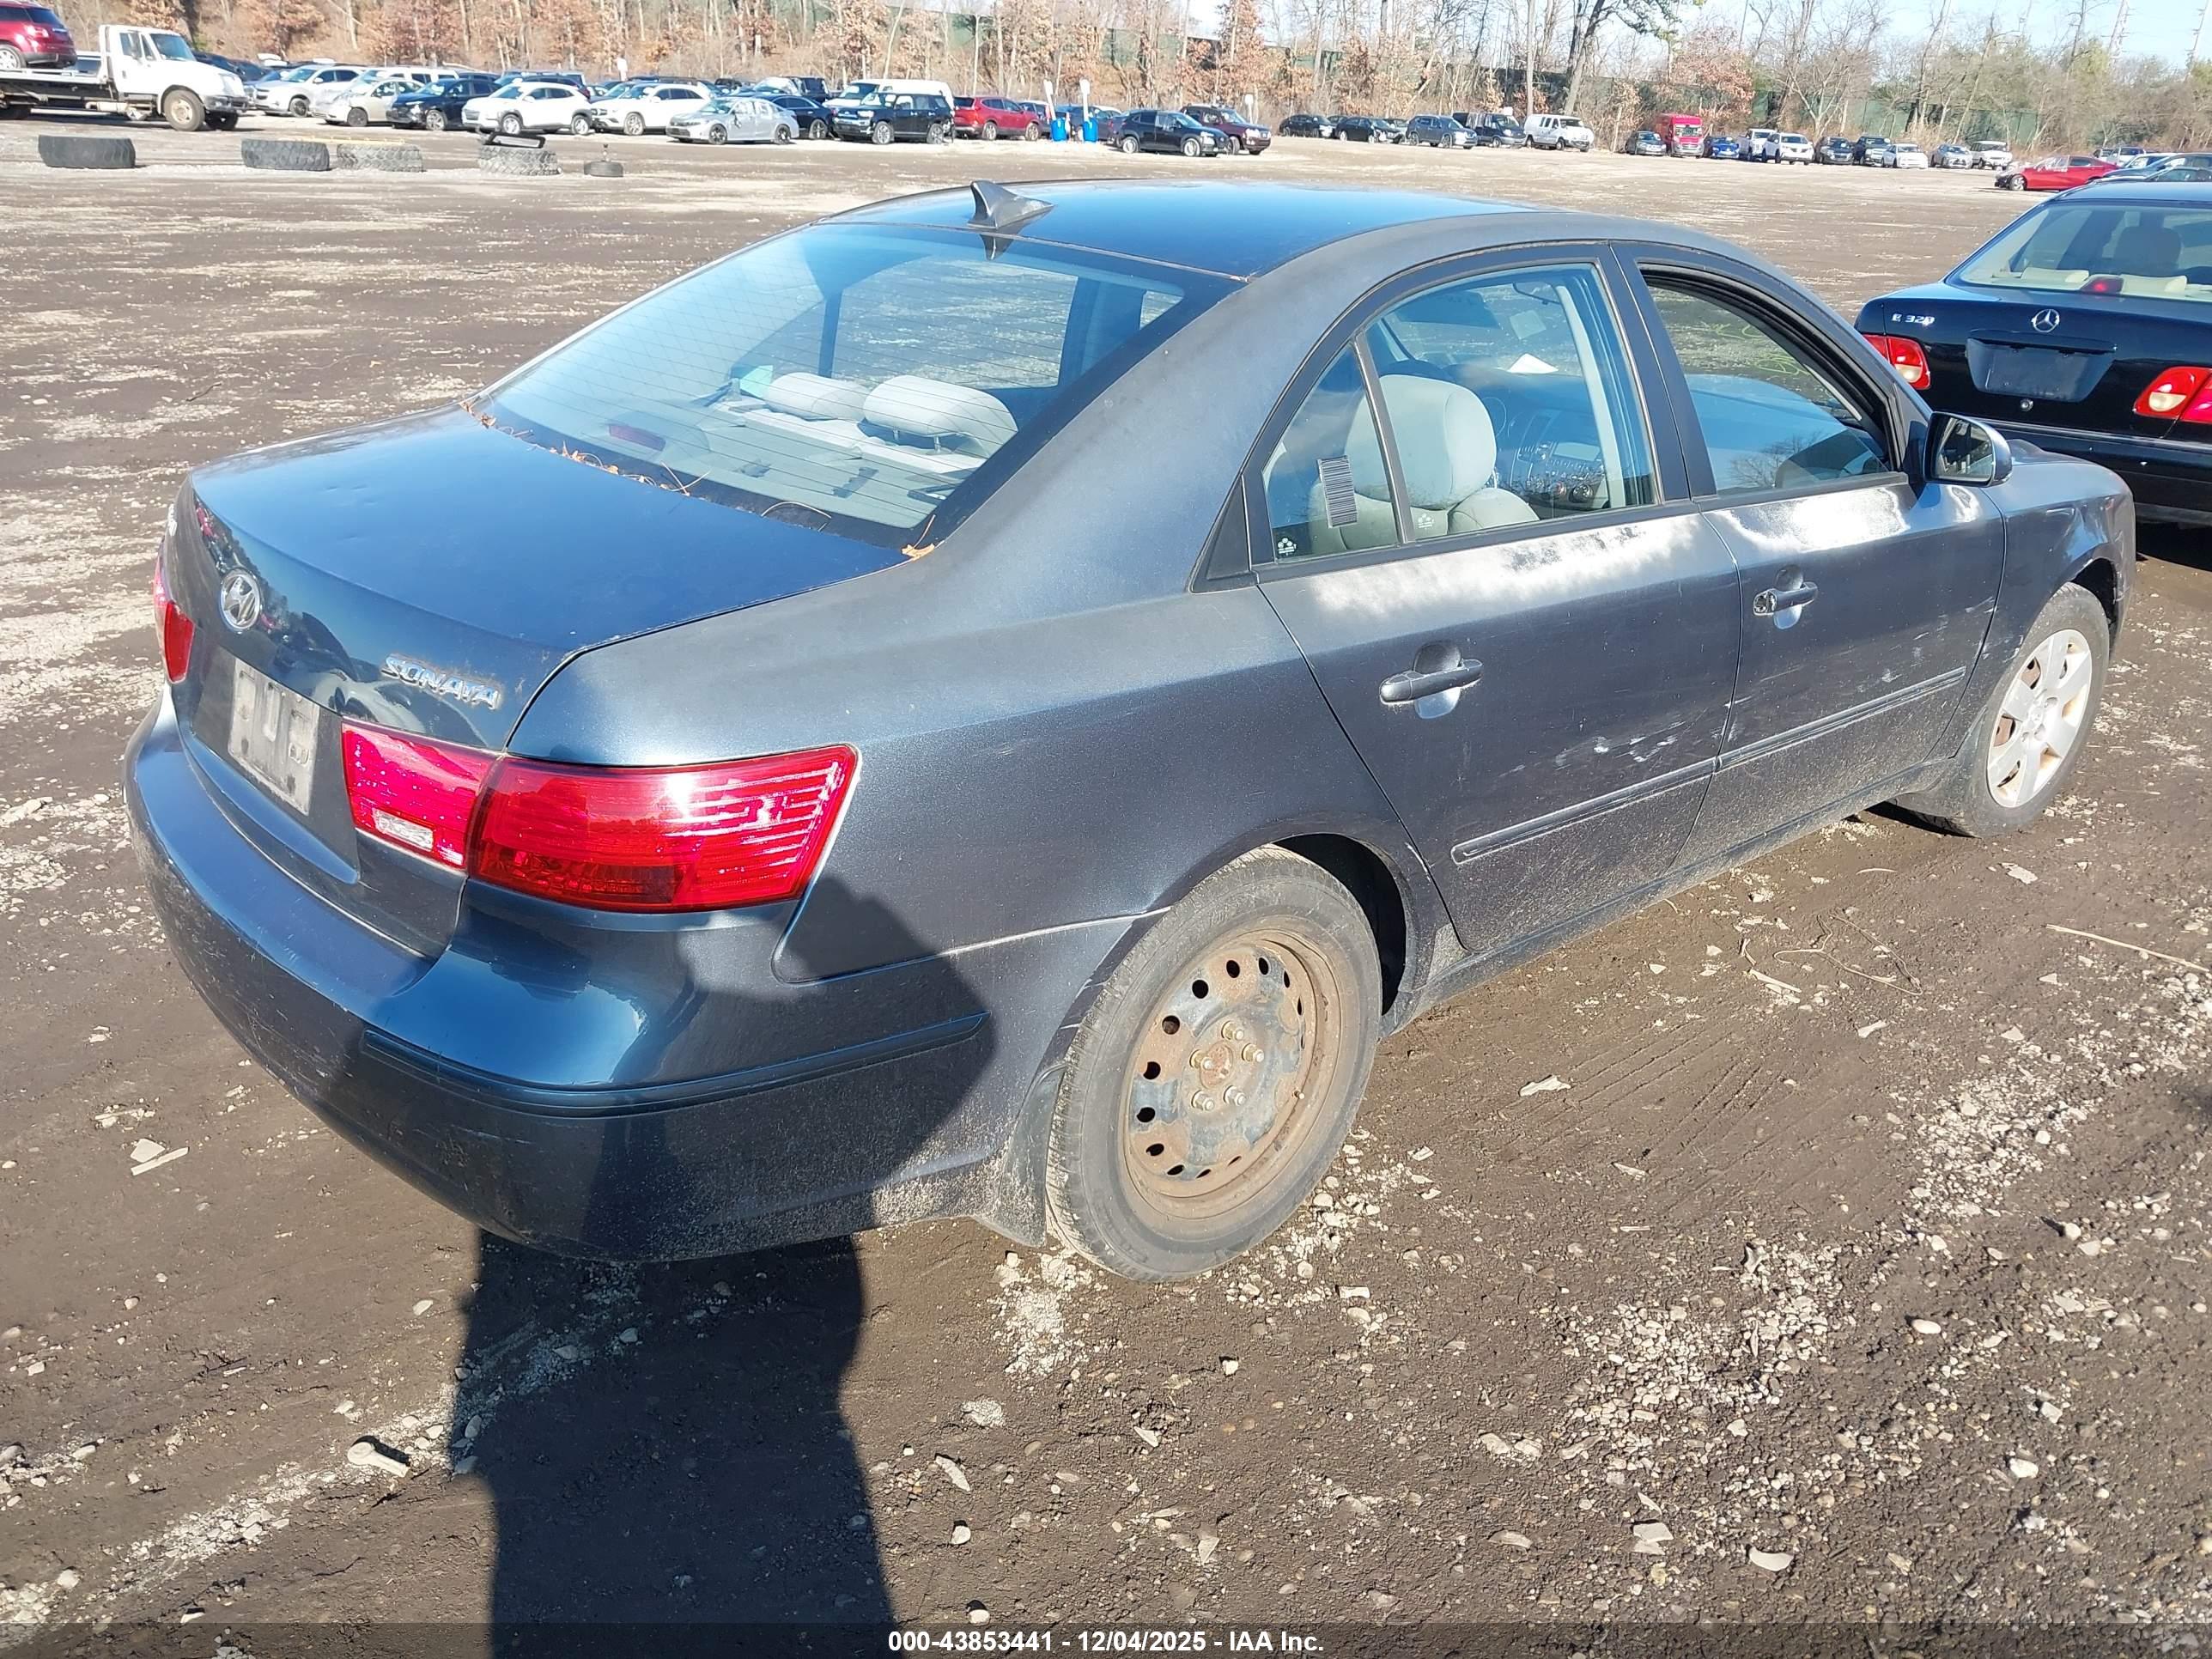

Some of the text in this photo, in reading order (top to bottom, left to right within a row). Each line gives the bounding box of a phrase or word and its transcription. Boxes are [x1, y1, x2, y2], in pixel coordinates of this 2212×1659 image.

[1892, 313, 1936, 325] E 320
[380, 655, 499, 710] SONATA
